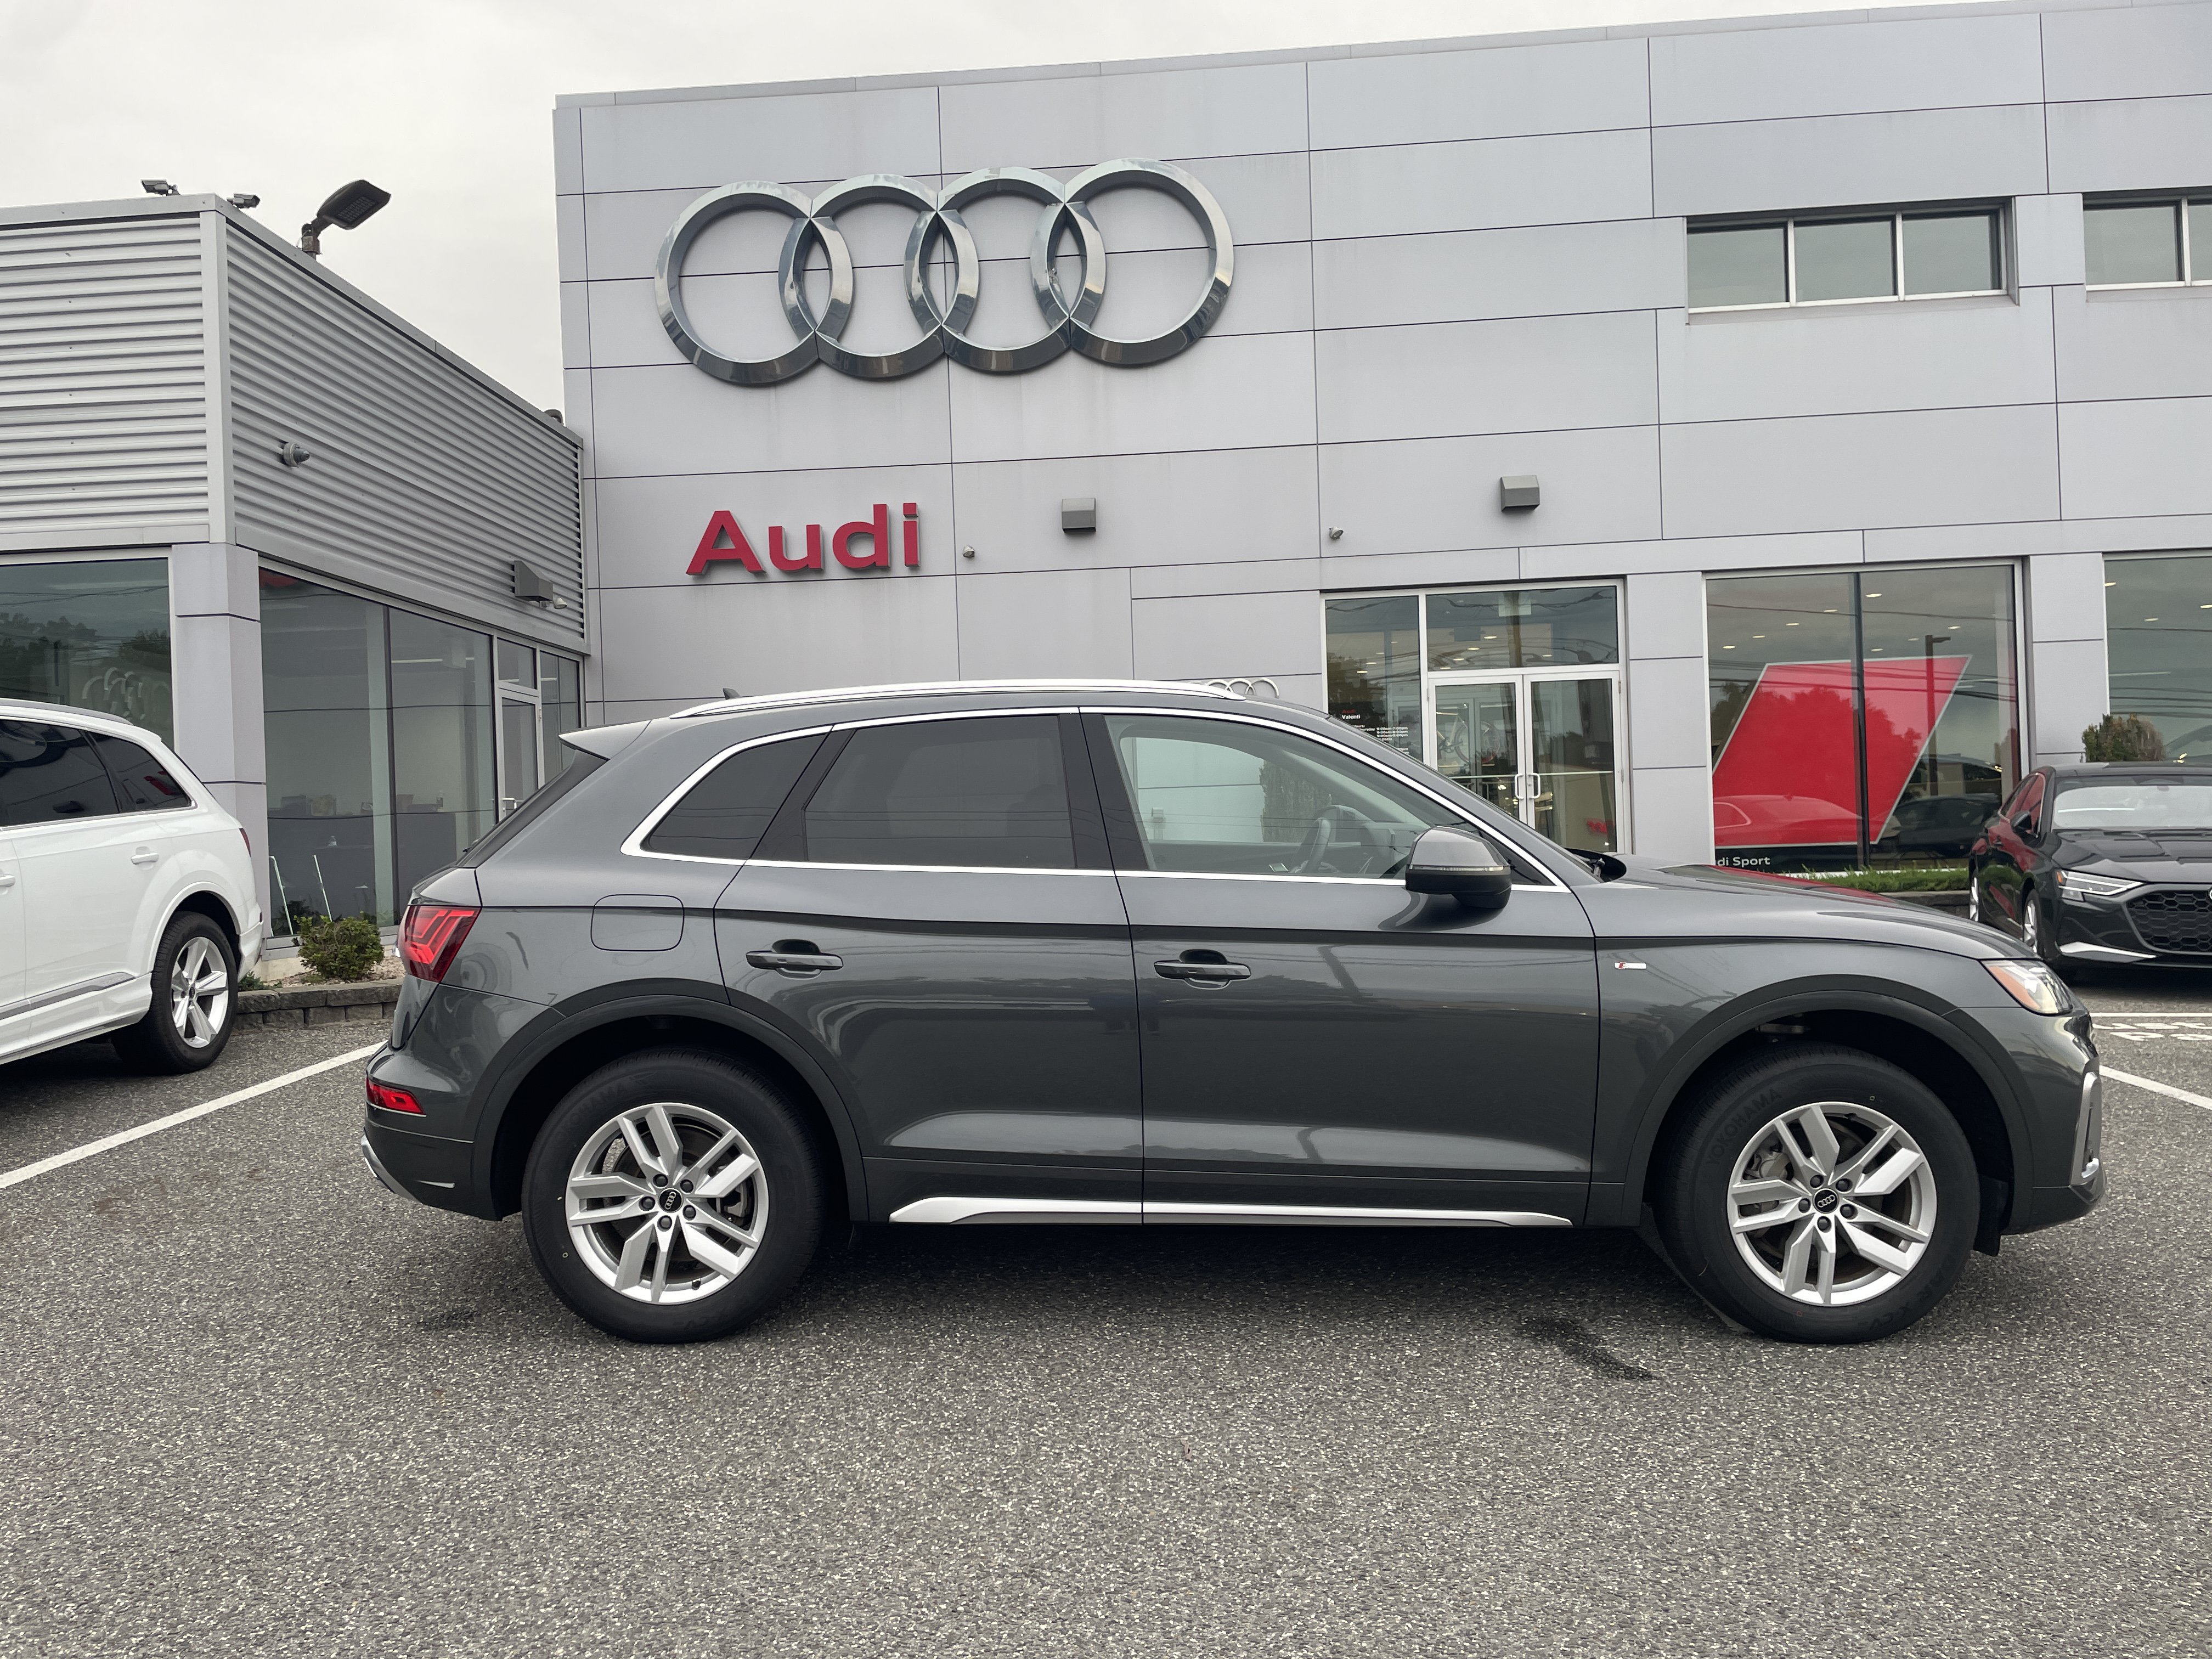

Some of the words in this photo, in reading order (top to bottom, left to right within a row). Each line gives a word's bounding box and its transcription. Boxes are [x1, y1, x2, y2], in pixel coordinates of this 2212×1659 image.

[686, 503, 920, 575] Audi
[1716, 857, 1729, 866] di
[1733, 856, 1771, 867] Sport
[1706, 1088, 1782, 1164] YOKOHAMA
